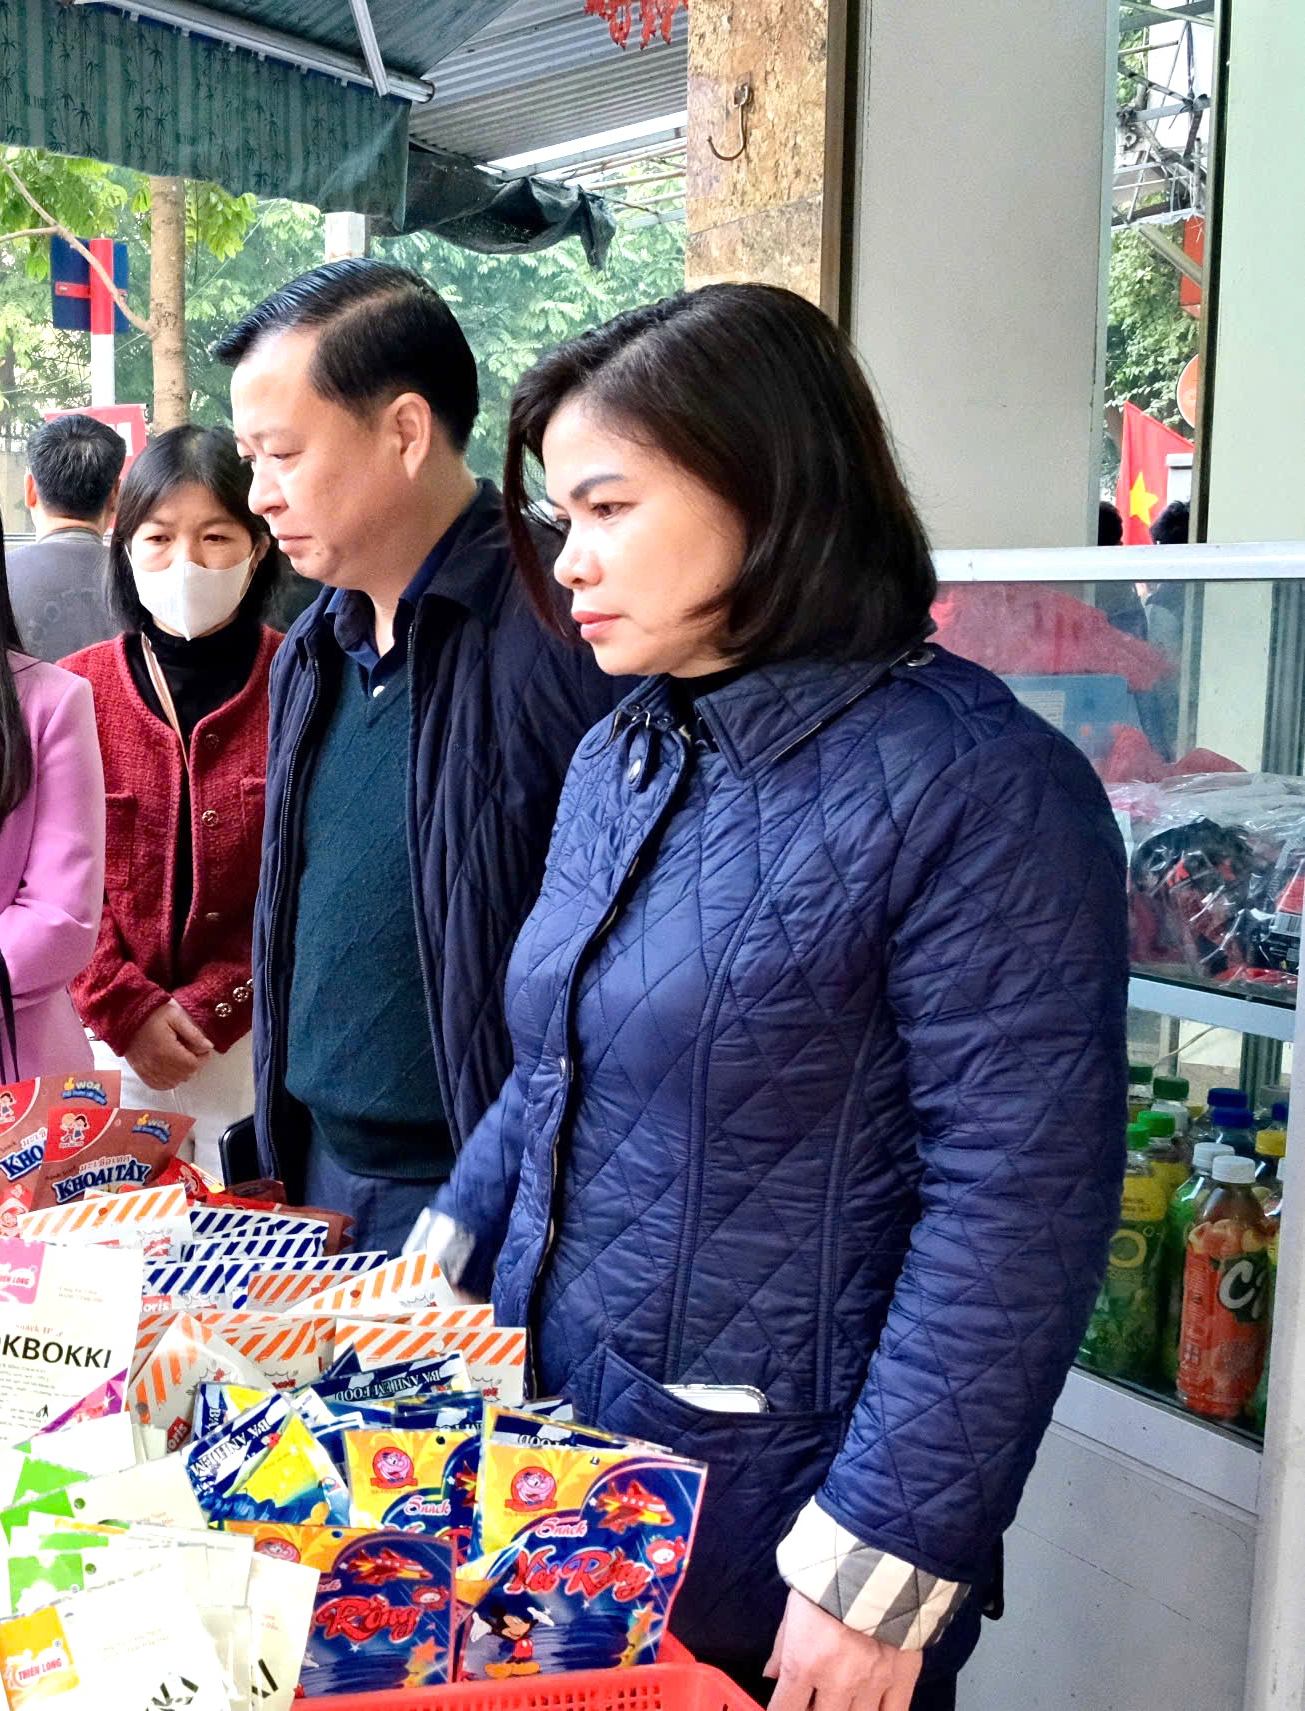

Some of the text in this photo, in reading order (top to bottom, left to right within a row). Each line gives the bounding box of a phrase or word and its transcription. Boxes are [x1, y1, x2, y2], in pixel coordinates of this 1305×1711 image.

[53, 1158, 151, 1203] KHOAI TÂY
[142, 1297, 170, 1312] oris
[167, 1423, 188, 1451] oris
[403, 1494, 452, 1517] Snack
[535, 1517, 588, 1539] Snack
[41, 1658, 62, 1673] LONG
